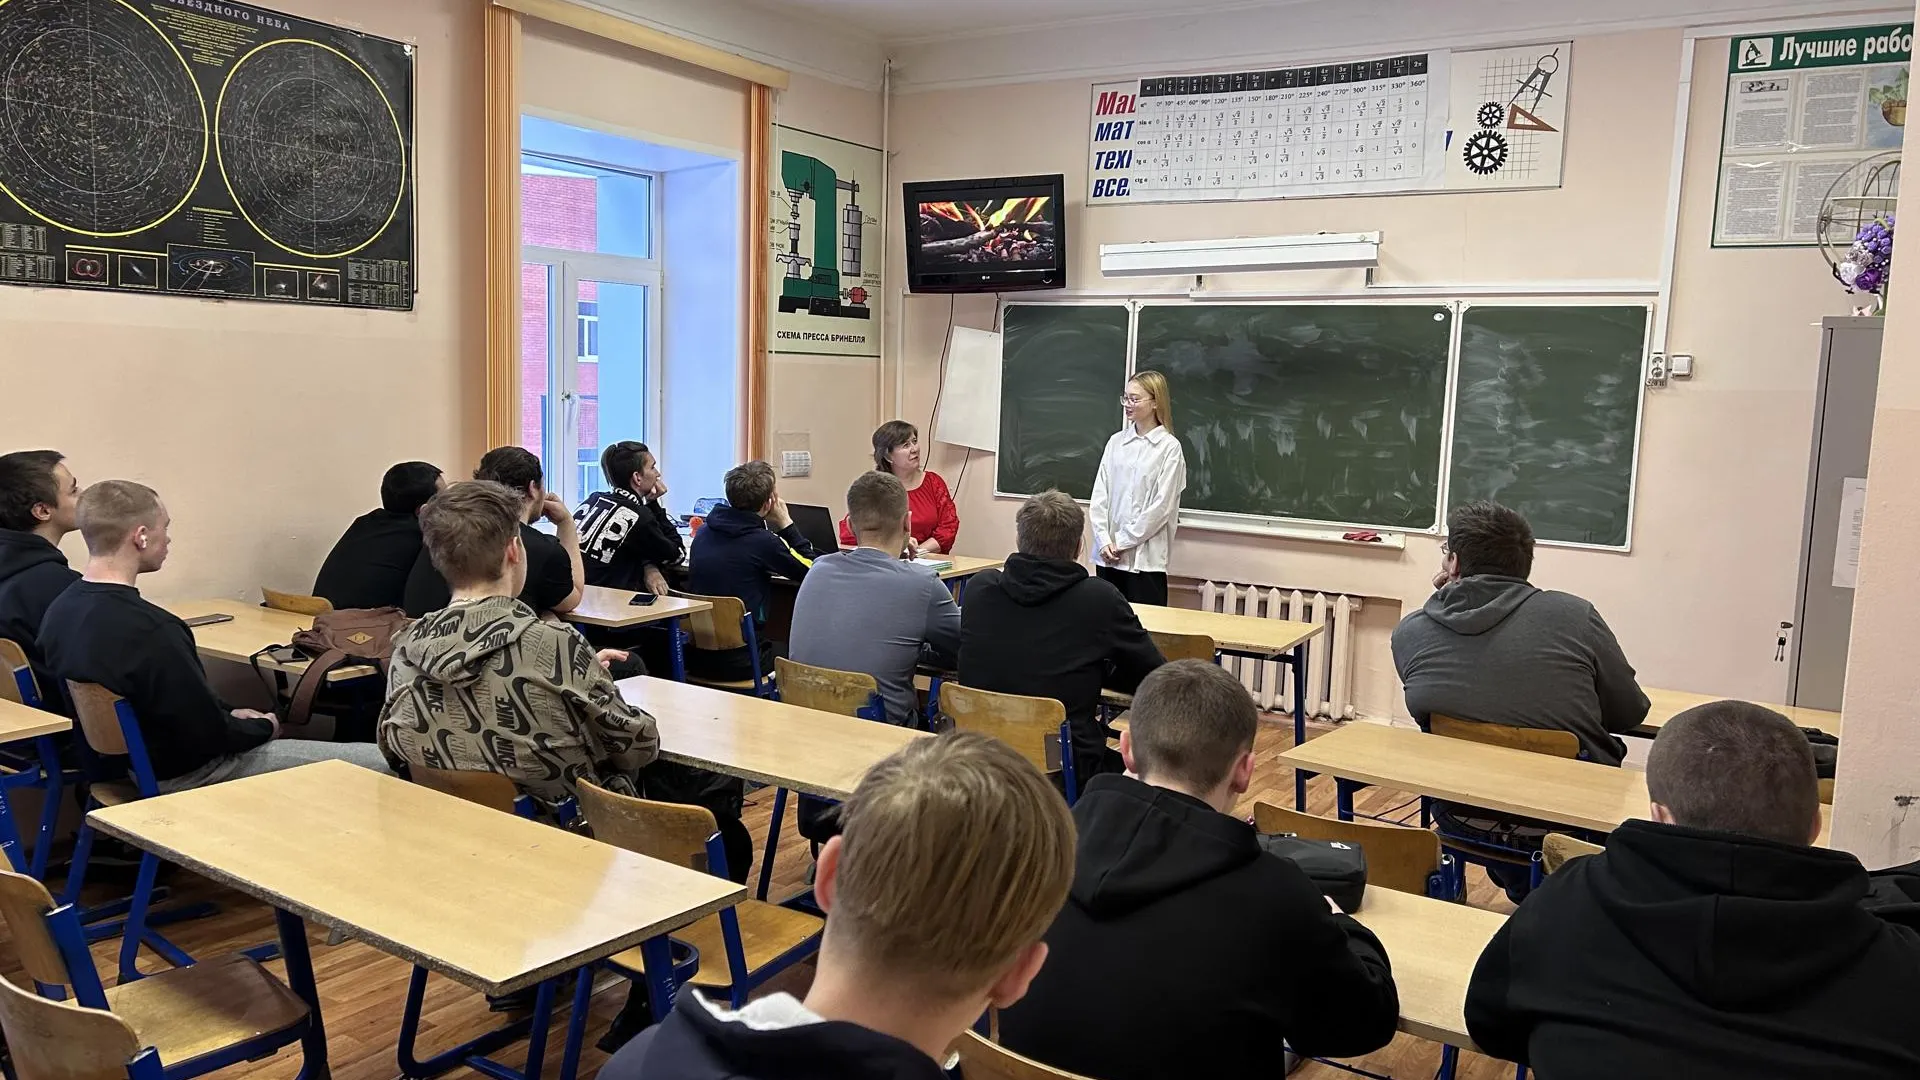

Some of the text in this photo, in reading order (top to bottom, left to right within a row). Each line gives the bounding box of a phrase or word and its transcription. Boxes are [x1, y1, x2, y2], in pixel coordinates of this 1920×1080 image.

[256, 15, 290, 31] НЕБА
[1779, 36, 1857, 66] Лучшие
[1093, 178, 1130, 197] все
[777, 331, 866, 343] СХЕМА ПРЕССА БРИНЕЛЛЯ
[479, 631, 509, 652] NIKE
[495, 696, 516, 729] NIKE
[495, 735, 517, 768] NIKE
